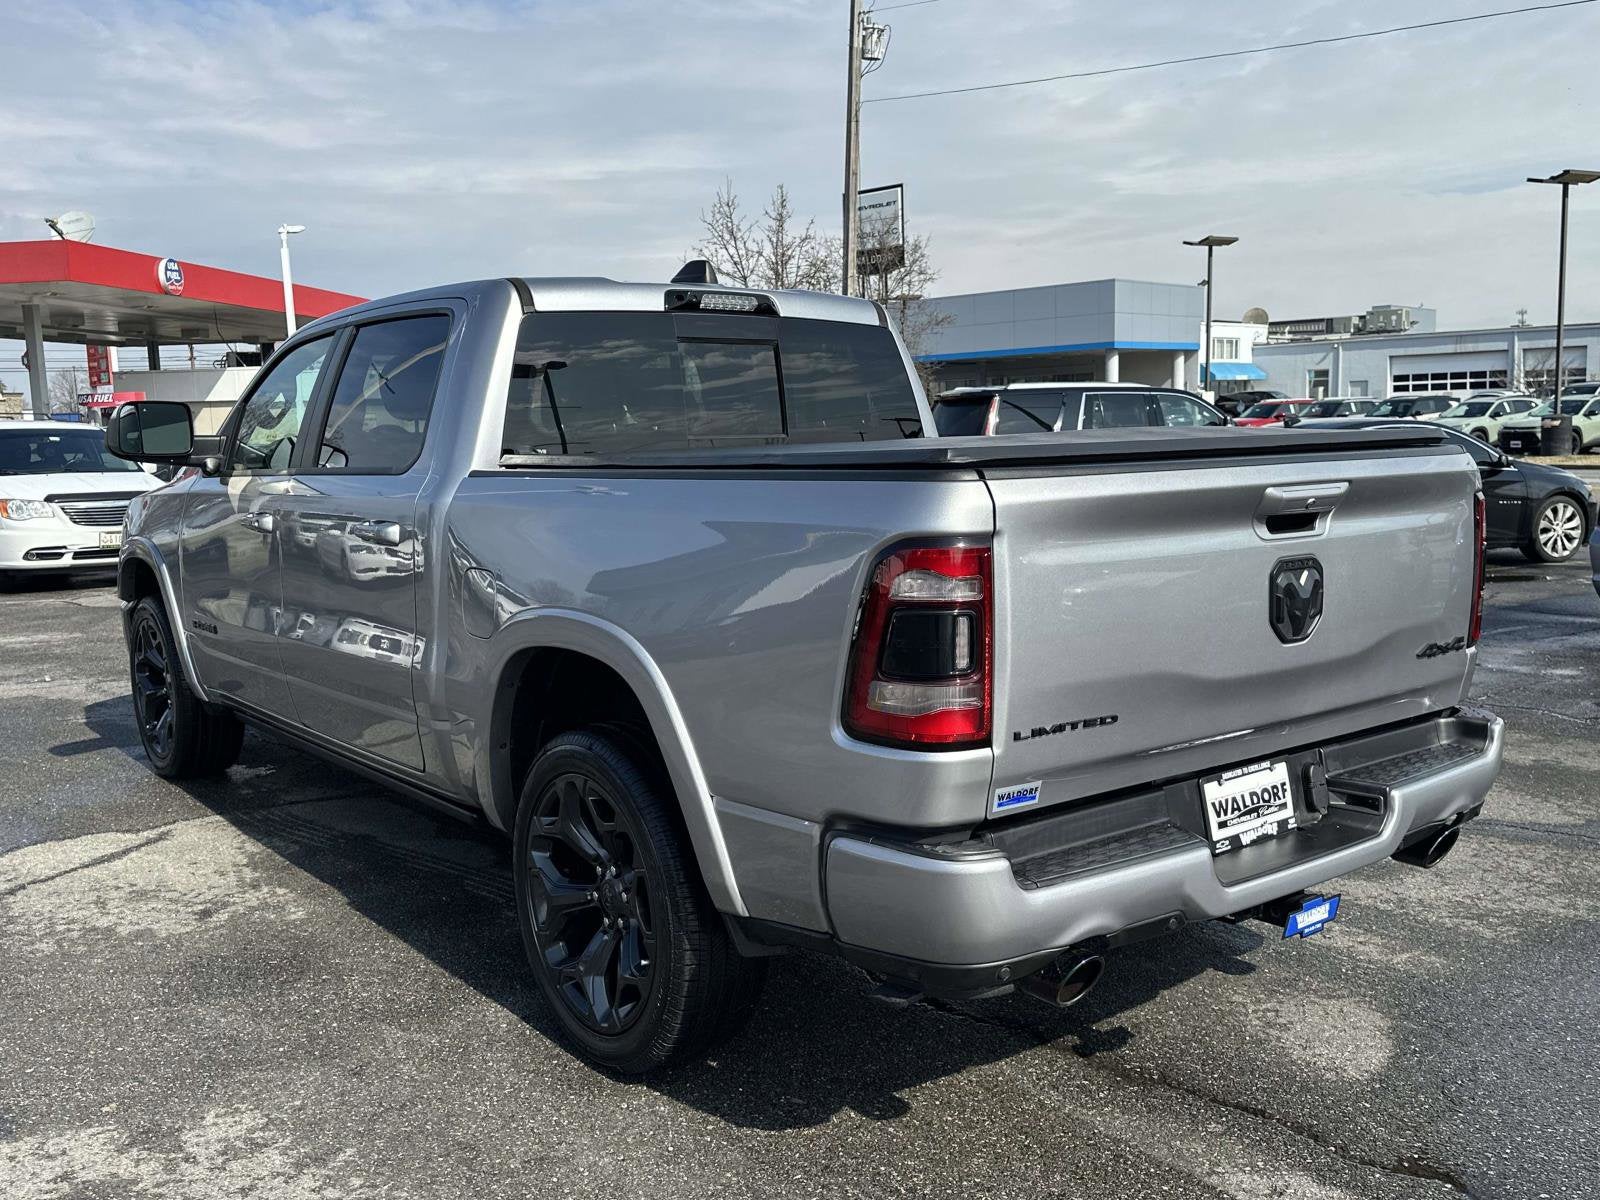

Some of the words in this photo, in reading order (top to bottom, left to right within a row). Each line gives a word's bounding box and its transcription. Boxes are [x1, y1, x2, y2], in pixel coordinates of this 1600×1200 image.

[167, 261, 179, 270] USA
[167, 271, 181, 280] FUEL
[79, 394, 92, 403] USA
[94, 394, 114, 403] FUEL
[1013, 714, 1119, 742] LIMITED
[997, 786, 1039, 802] WALDORF
[1211, 781, 1287, 819] WALDORF
[1227, 812, 1258, 827] CHEVROLET
[1239, 822, 1279, 846] WALDORF
